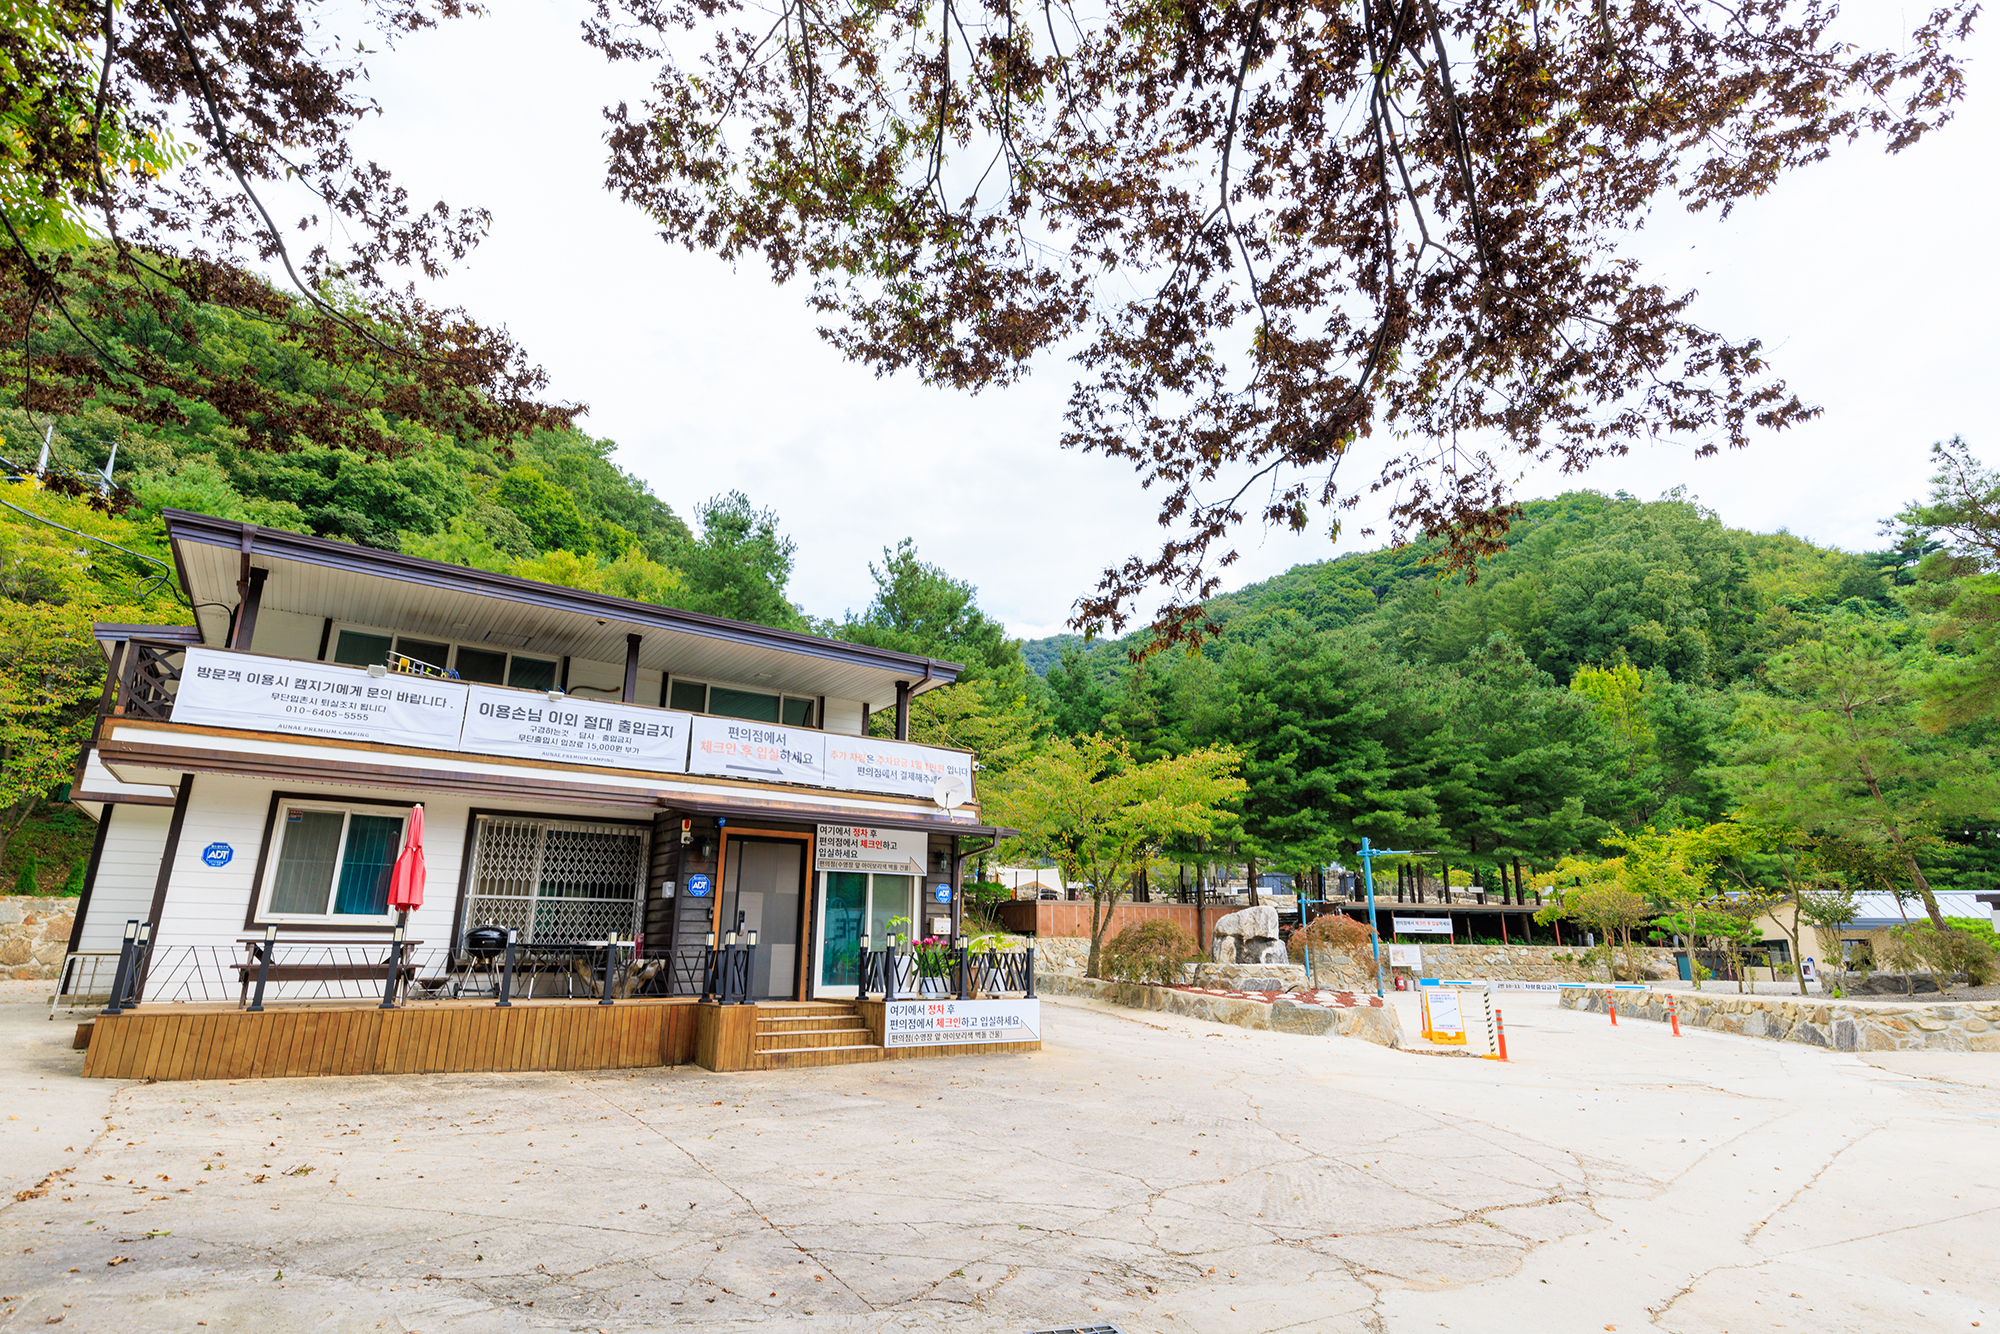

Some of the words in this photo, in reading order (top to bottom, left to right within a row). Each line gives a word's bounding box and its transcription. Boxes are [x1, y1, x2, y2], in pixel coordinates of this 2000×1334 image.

[197, 666, 241, 682] 방문객
[246, 672, 289, 687] 이용시
[294, 676, 363, 697] 캠지기에게
[367, 687, 392, 700] 문의
[285, 705, 369, 721] 010-6405-5555
[320, 699, 357, 710] 퇴실조치
[360, 703, 387, 713] 됩니다
[479, 702, 543, 723] 이용손님
[548, 710, 578, 727] 이외
[584, 715, 613, 731] 절대
[618, 719, 674, 739] 출입금지
[277, 723, 302, 731] AUNAE
[304, 726, 337, 734] PREMIUM
[339, 730, 370, 738] CAMPING
[530, 725, 569, 737] 구경하는것
[602, 734, 632, 744] 출입금지
[728, 726, 787, 746] 편의점에서
[518, 733, 558, 745] 무단출입시
[560, 739, 584, 748] 입장료
[587, 742, 623, 752] 15,000원
[625, 746, 640, 755] 부가
[700, 740, 736, 756] 체크인
[740, 744, 753, 758] 후
[756, 746, 814, 765] 입실하세요
[830, 750, 847, 761] 추가
[849, 753, 875, 764] 차량은
[877, 755, 909, 768] 주차요금
[910, 760, 923, 770] 1일
[946, 765, 969, 777] 입니다
[857, 766, 898, 780] 편의점에서
[819, 825, 851, 835] 여기에서
[852, 828, 868, 838] 정차
[869, 829, 877, 838] 후
[819, 837, 859, 848] 편의점에서
[860, 840, 898, 850] 체크인하고
[207, 850, 230, 860] ADT
[819, 848, 858, 859] 입실하세요
[692, 881, 707, 889] ADT
[938, 889, 950, 897] ADT
[890, 1004, 925, 1017] 여기에서
[927, 1004, 945, 1016] 정차
[946, 1004, 956, 1015] 후
[890, 1018, 934, 1031] 편의점에서
[936, 1016, 978, 1029] 체크인하고
[980, 1015, 1020, 1027] 입실하세요
[891, 1033, 933, 1043] 편의점(수영장
[942, 1031, 974, 1040] 아이보리색
[989, 1030, 1003, 1039] 건물)
